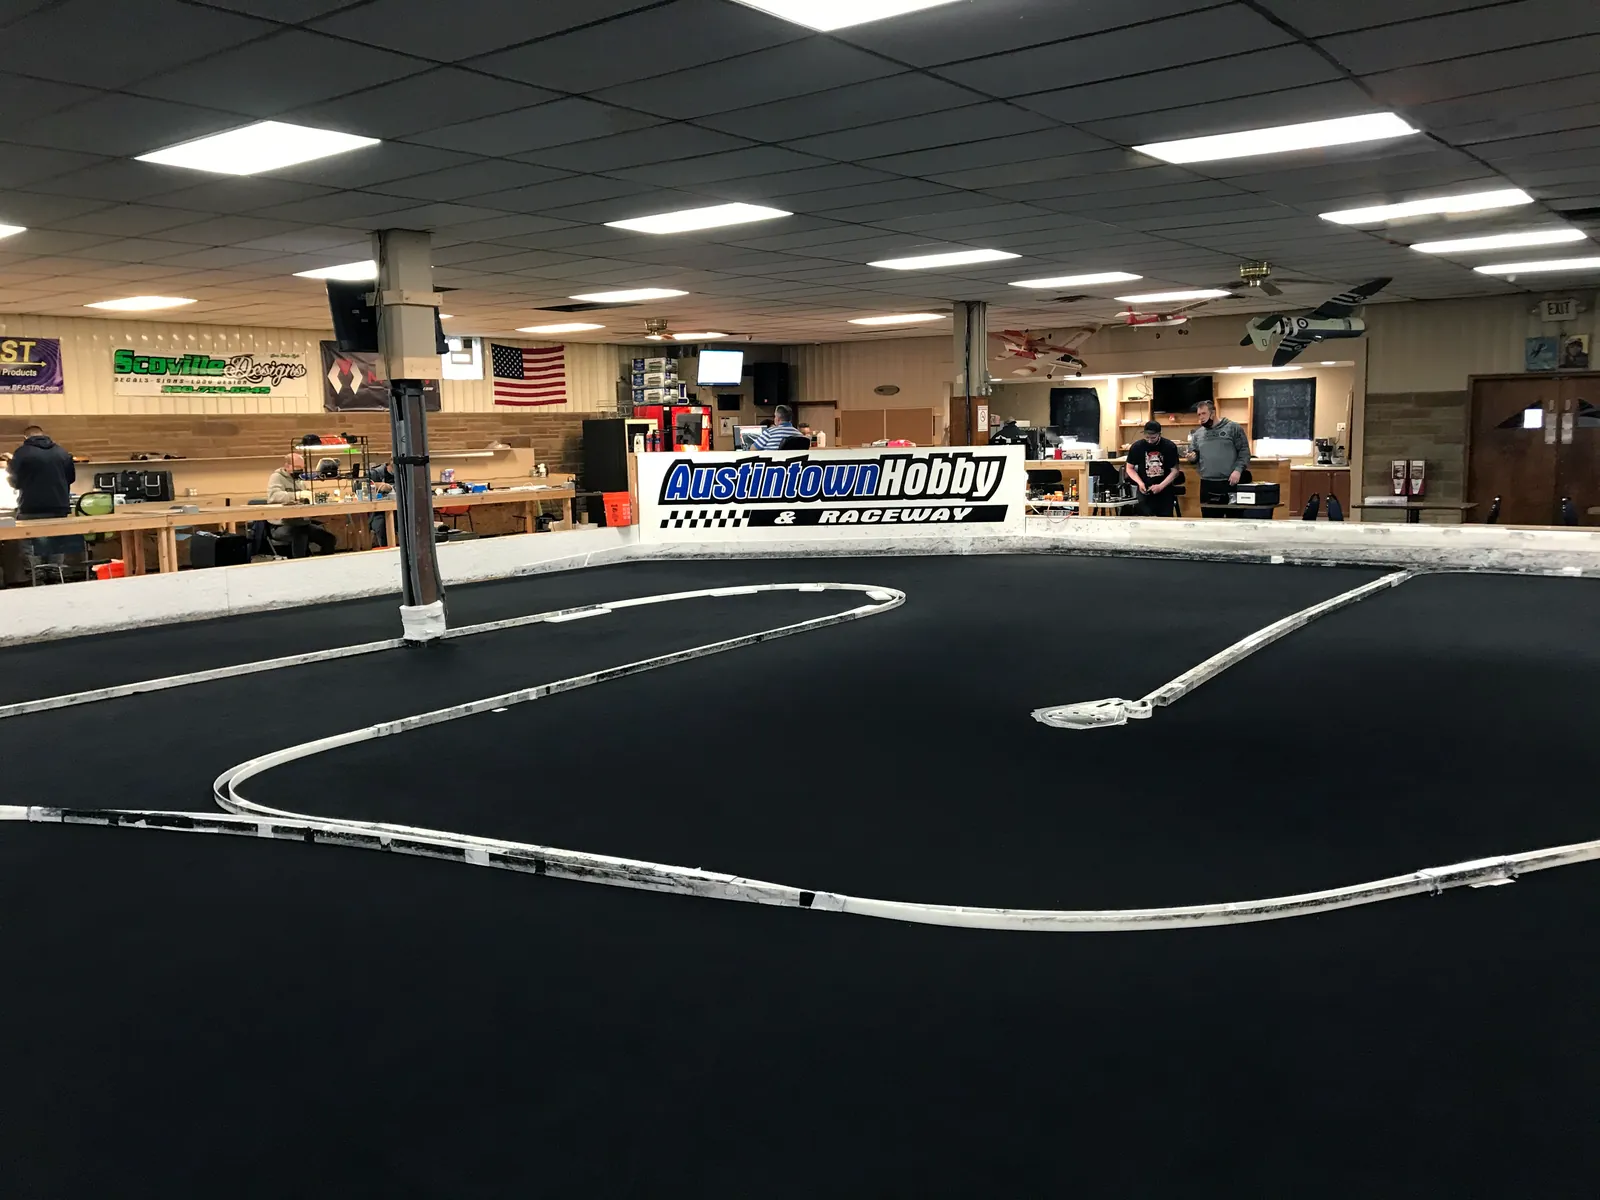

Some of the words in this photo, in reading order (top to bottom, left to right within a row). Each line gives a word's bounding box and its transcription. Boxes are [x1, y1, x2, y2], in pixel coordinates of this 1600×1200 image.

[1547, 302, 1570, 315] EXIT
[0, 339, 37, 363] ST
[2, 367, 37, 377] Products
[774, 510, 797, 525] &
[817, 506, 974, 525] RACEWAY
